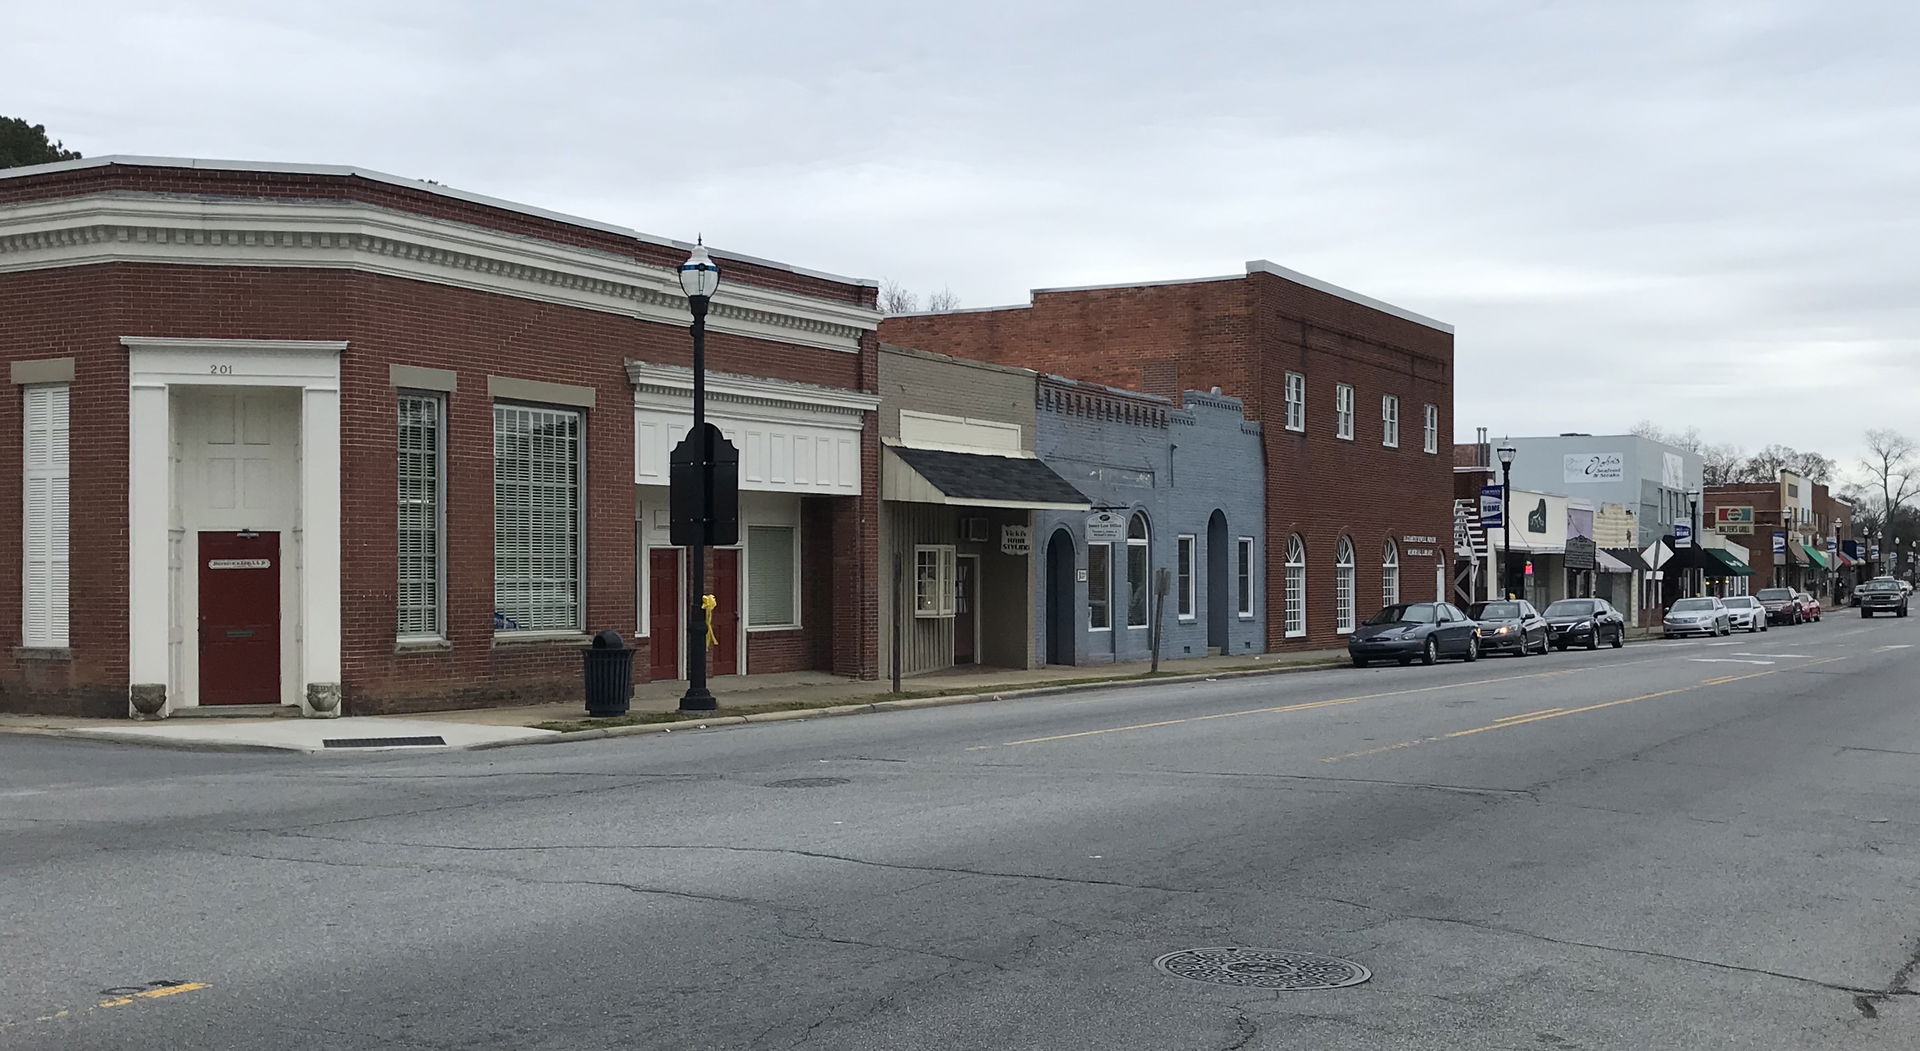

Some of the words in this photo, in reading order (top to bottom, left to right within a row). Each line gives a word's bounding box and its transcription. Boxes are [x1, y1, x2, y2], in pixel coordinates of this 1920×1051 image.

[211, 364, 232, 374] 201
[1483, 504, 1501, 512] HOME
[1002, 543, 1031, 551] STYLING
